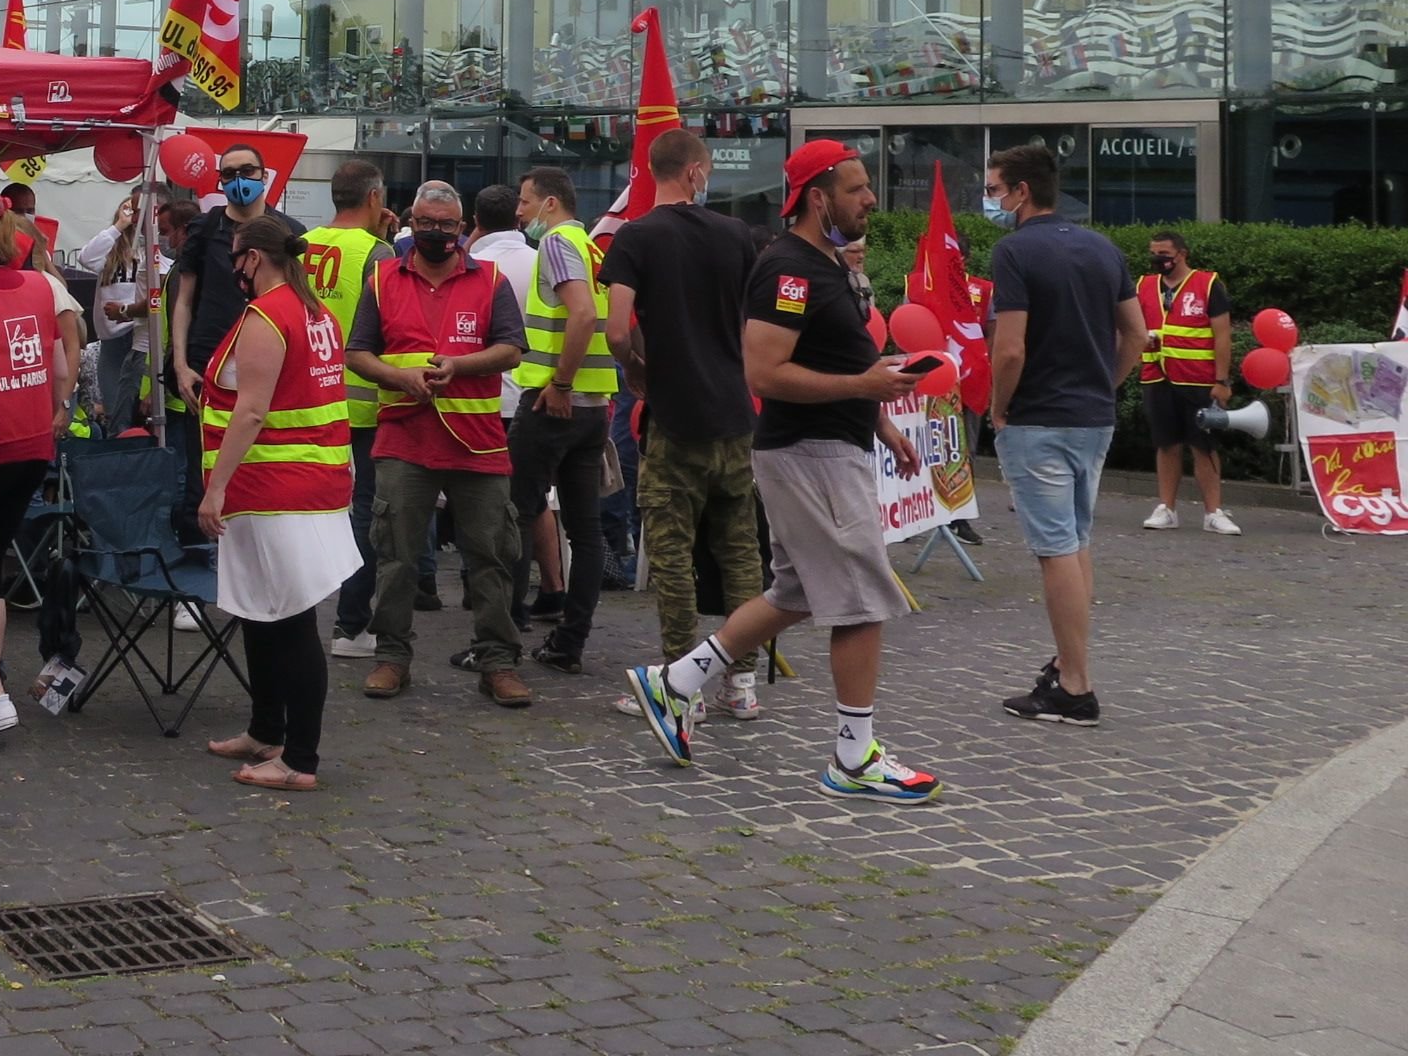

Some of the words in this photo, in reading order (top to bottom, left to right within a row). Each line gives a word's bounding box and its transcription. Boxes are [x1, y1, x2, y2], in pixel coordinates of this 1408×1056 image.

[161, 19, 188, 49] UL
[208, 75, 235, 98] 95
[711, 148, 752, 162] ACCUEIL
[1099, 138, 1174, 156] ACCUEIL
[303, 243, 342, 292] FO
[781, 285, 805, 300] cgt
[307, 313, 339, 361] cgt
[457, 320, 476, 333] cgt
[11, 333, 42, 364] cgt
[1332, 487, 1408, 526] cgt
